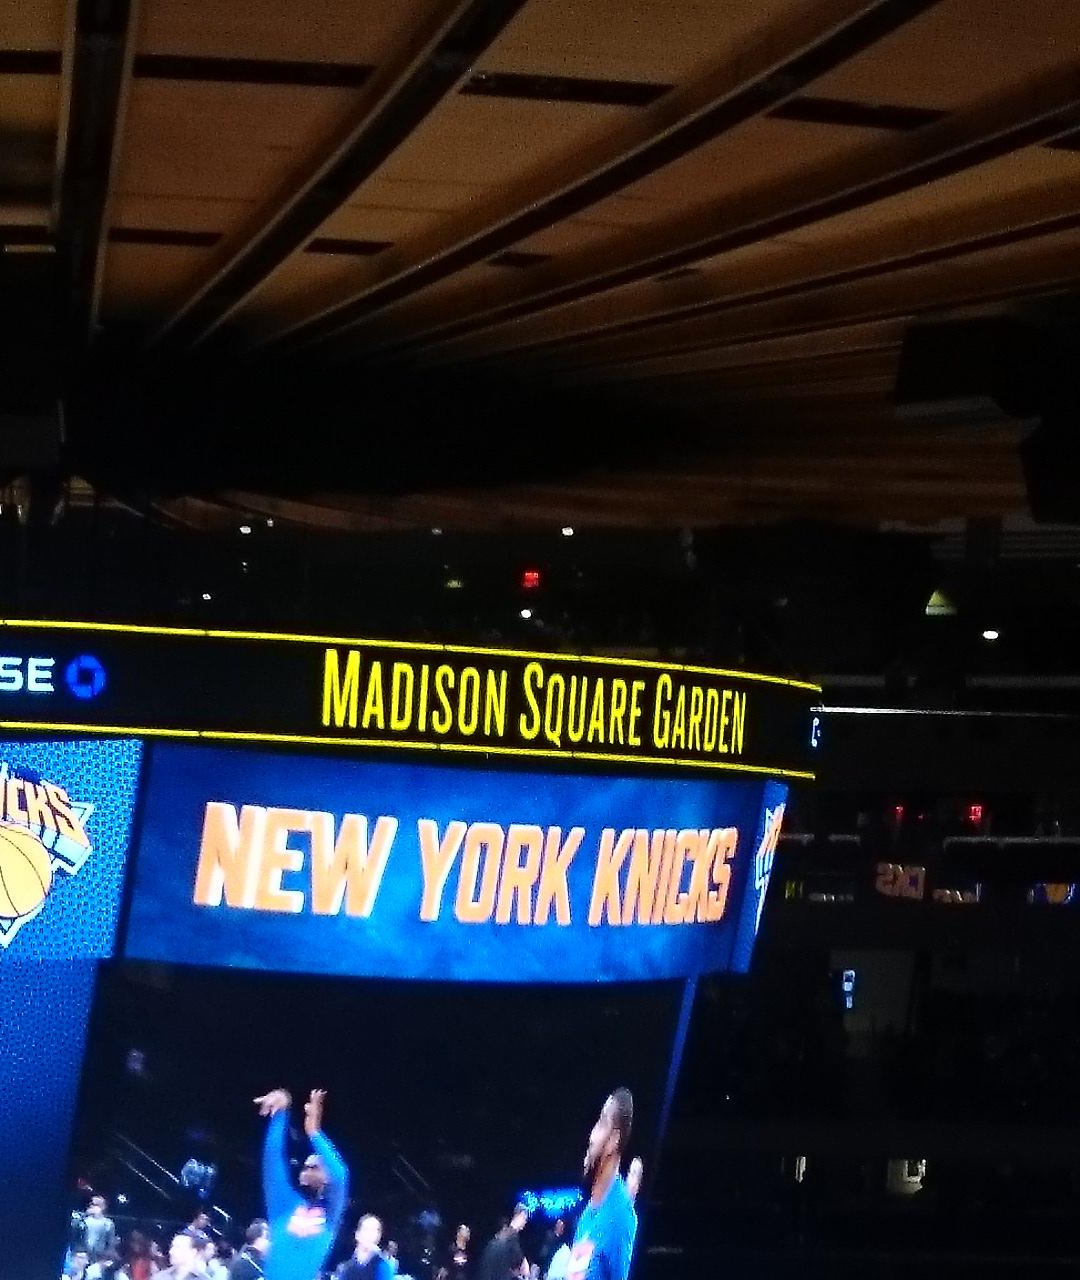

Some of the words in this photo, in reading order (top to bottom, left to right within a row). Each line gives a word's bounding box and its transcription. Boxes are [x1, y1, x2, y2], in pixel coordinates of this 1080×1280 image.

[322, 649, 508, 736] MADISON
[519, 660, 644, 747] SQUARE
[653, 672, 747, 754] GARDEN
[193, 801, 397, 919] NEW
[417, 819, 583, 924] YORK
[587, 827, 739, 926] KNICKS
